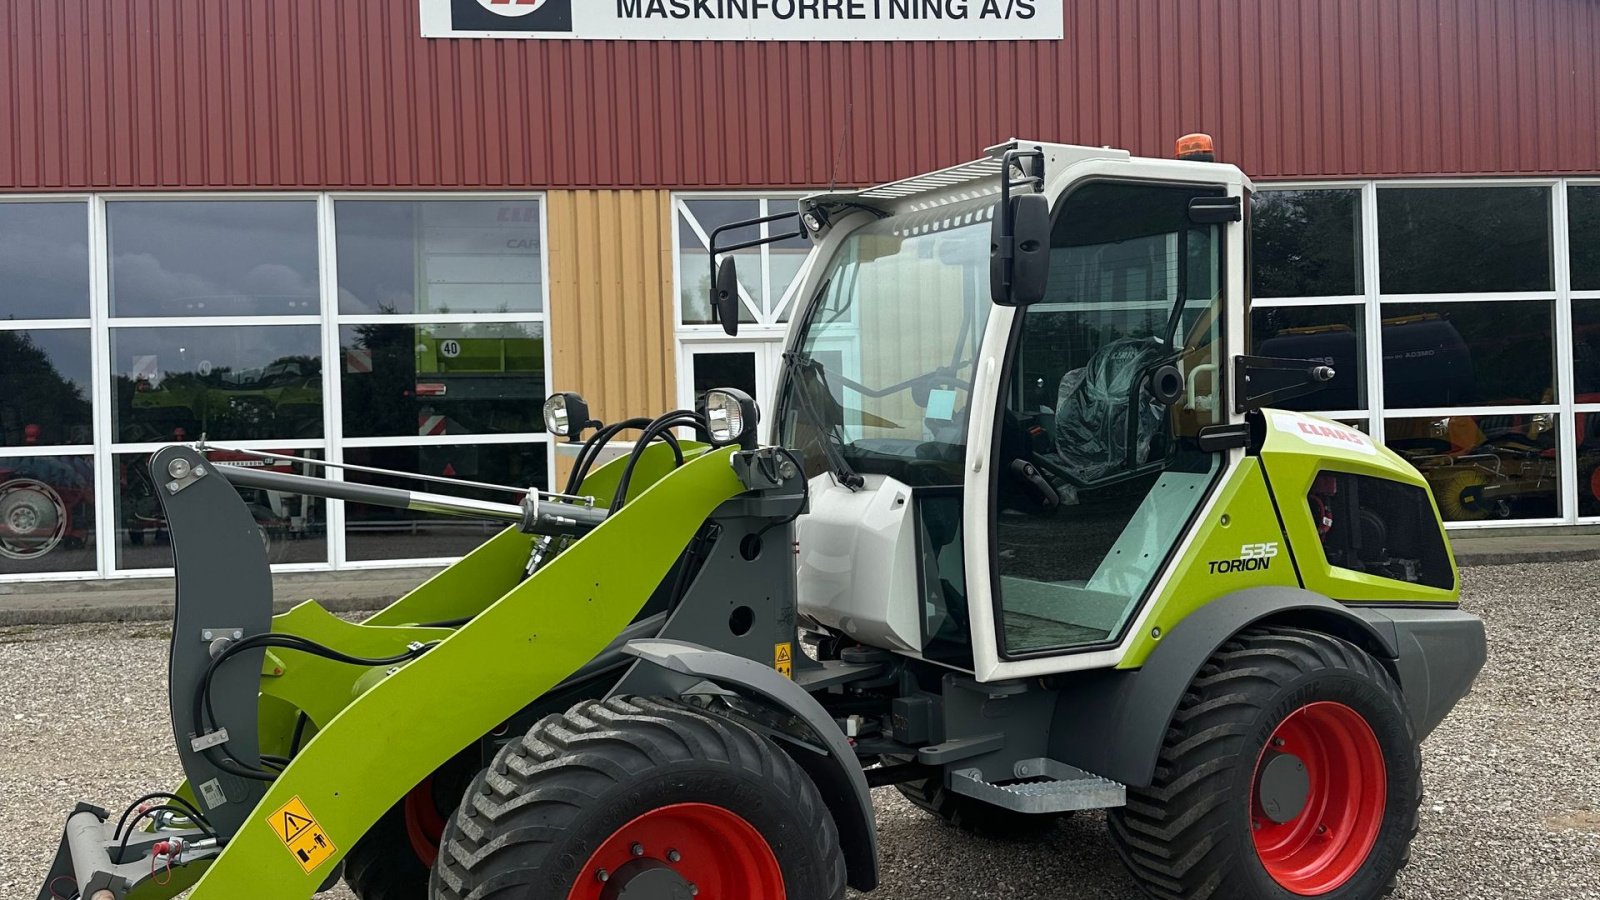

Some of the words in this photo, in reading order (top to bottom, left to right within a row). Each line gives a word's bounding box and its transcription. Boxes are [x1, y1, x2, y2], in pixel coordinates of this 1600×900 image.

[979, 0, 1036, 20] A/S
[444, 342, 457, 355] 40
[1297, 422, 1364, 446] CLAAS
[1240, 542, 1278, 559] 535
[1208, 557, 1270, 574] TORION
